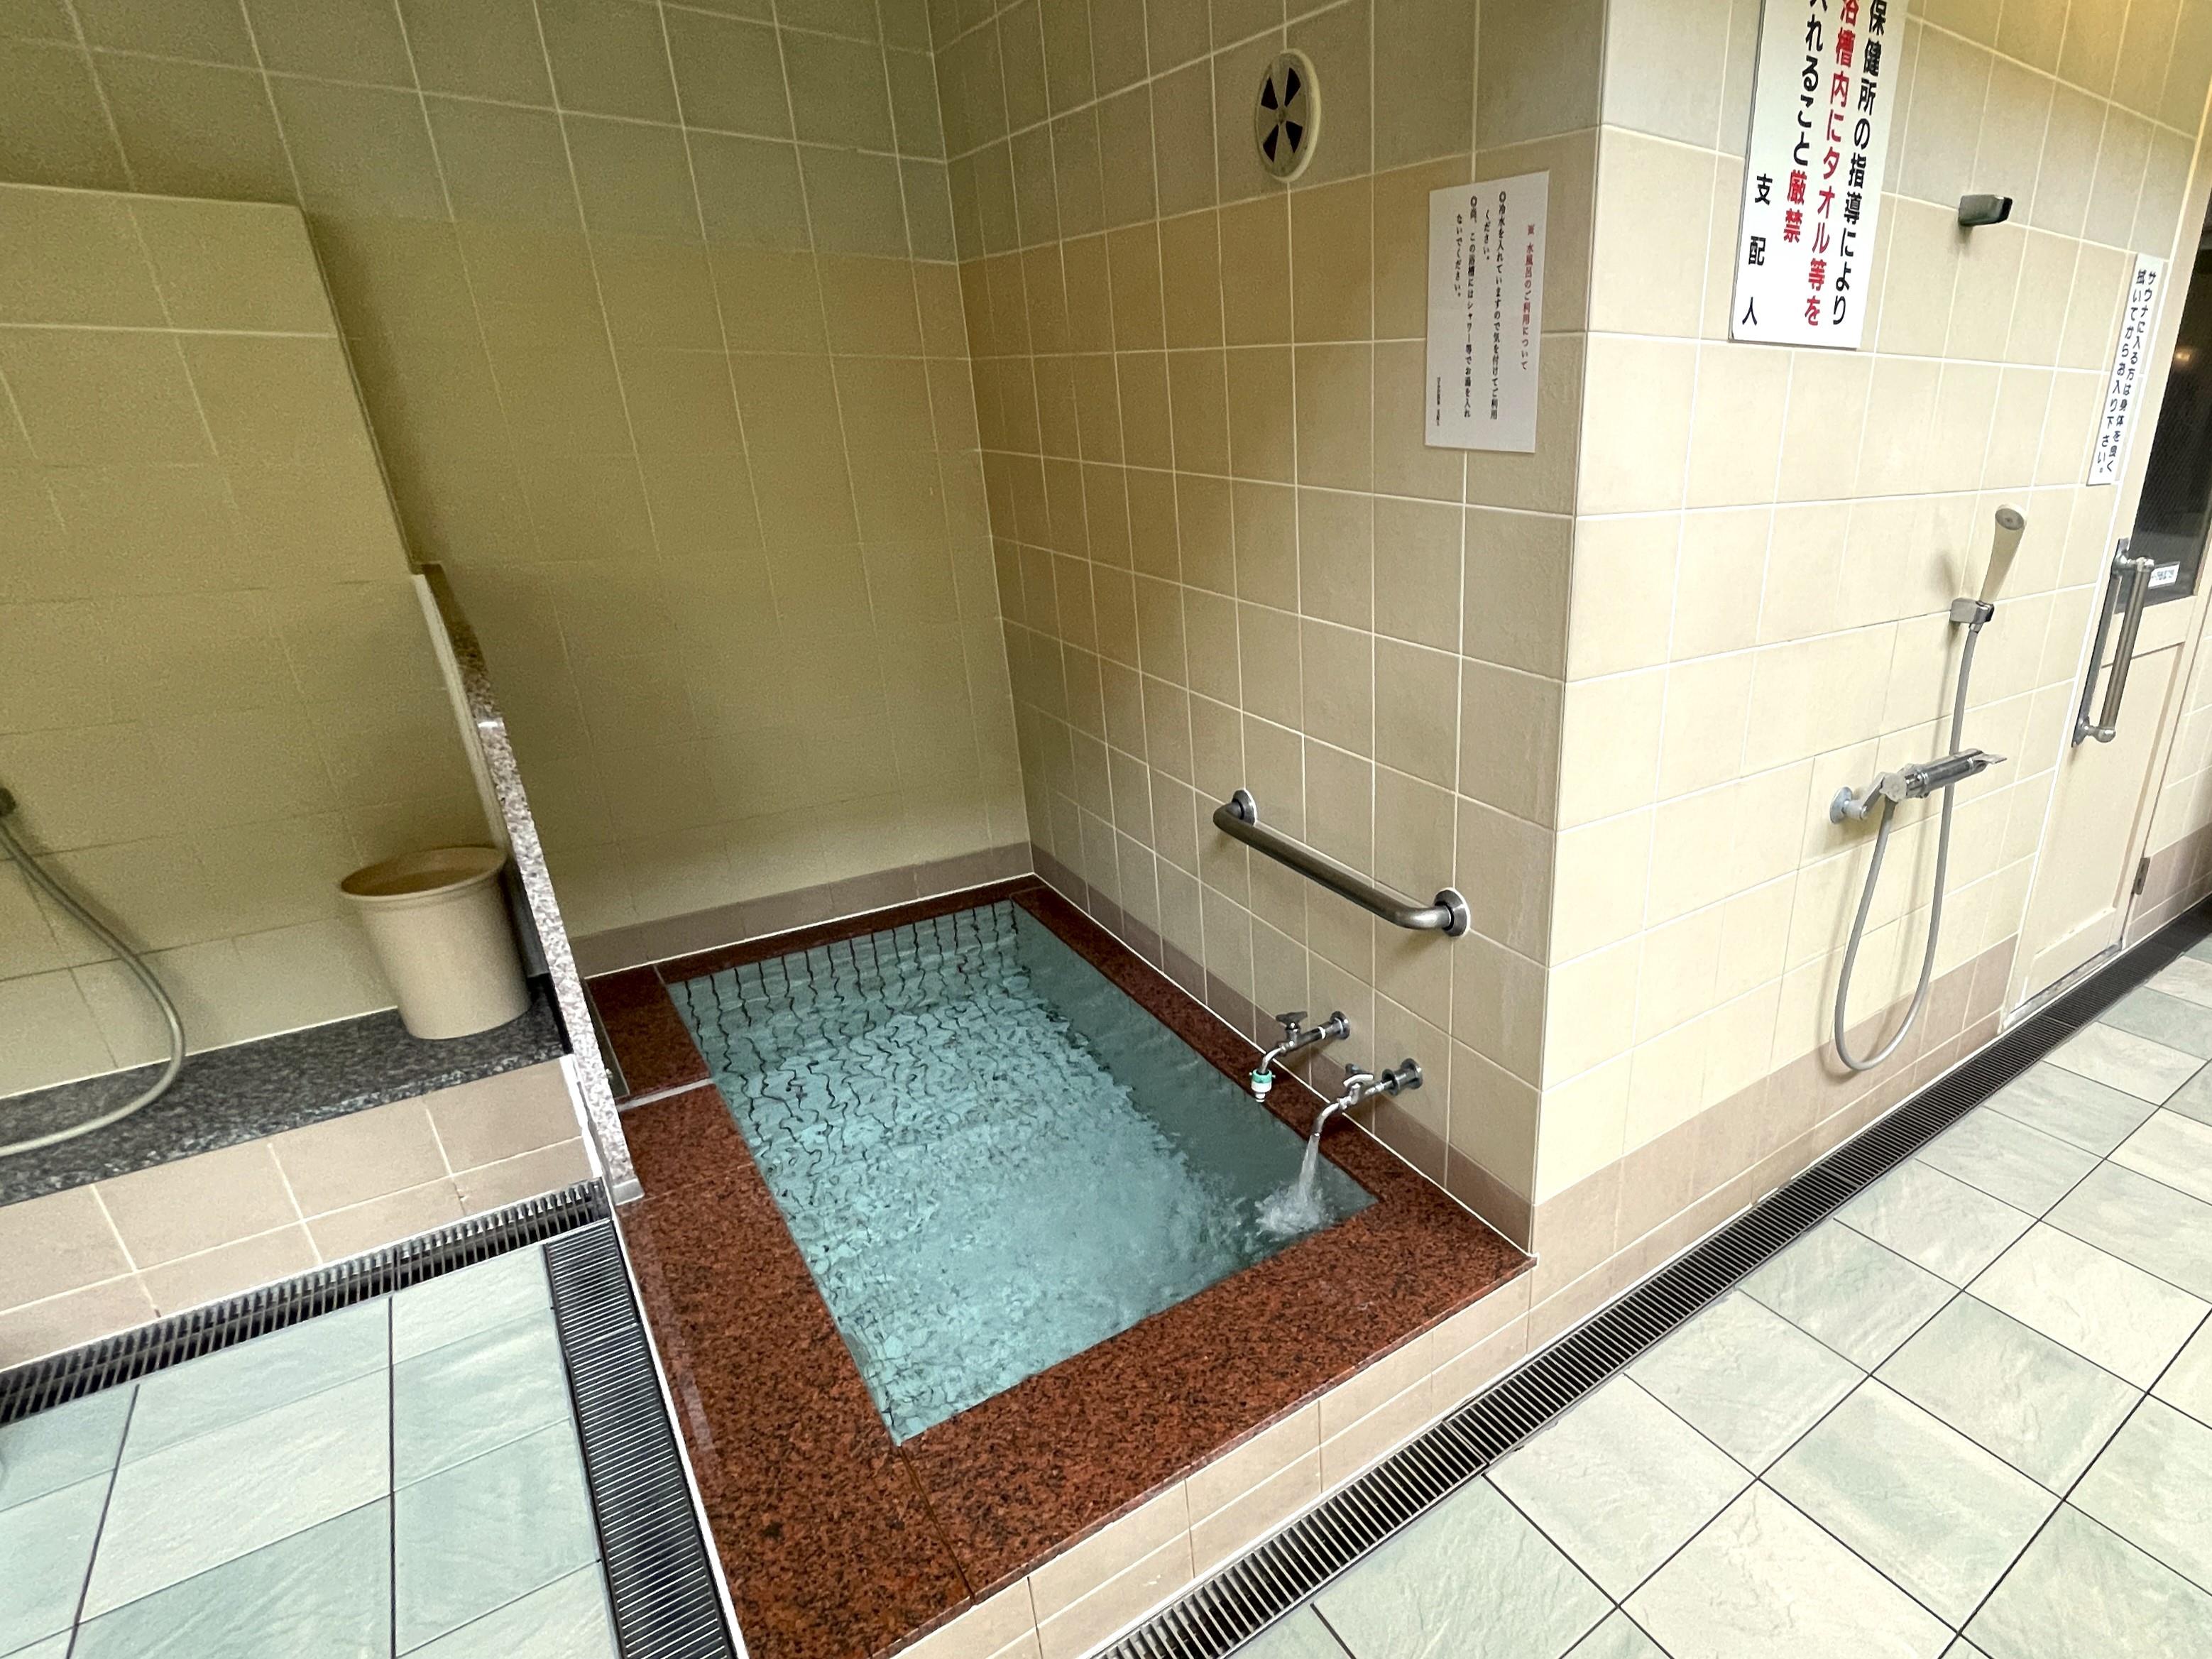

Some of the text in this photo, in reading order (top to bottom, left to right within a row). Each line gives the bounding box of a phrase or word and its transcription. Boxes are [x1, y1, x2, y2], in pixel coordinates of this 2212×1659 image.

[1805, 0, 1859, 326] 浴槽内にタオル等を
[1833, 0, 1887, 325] 保健所の指導により
